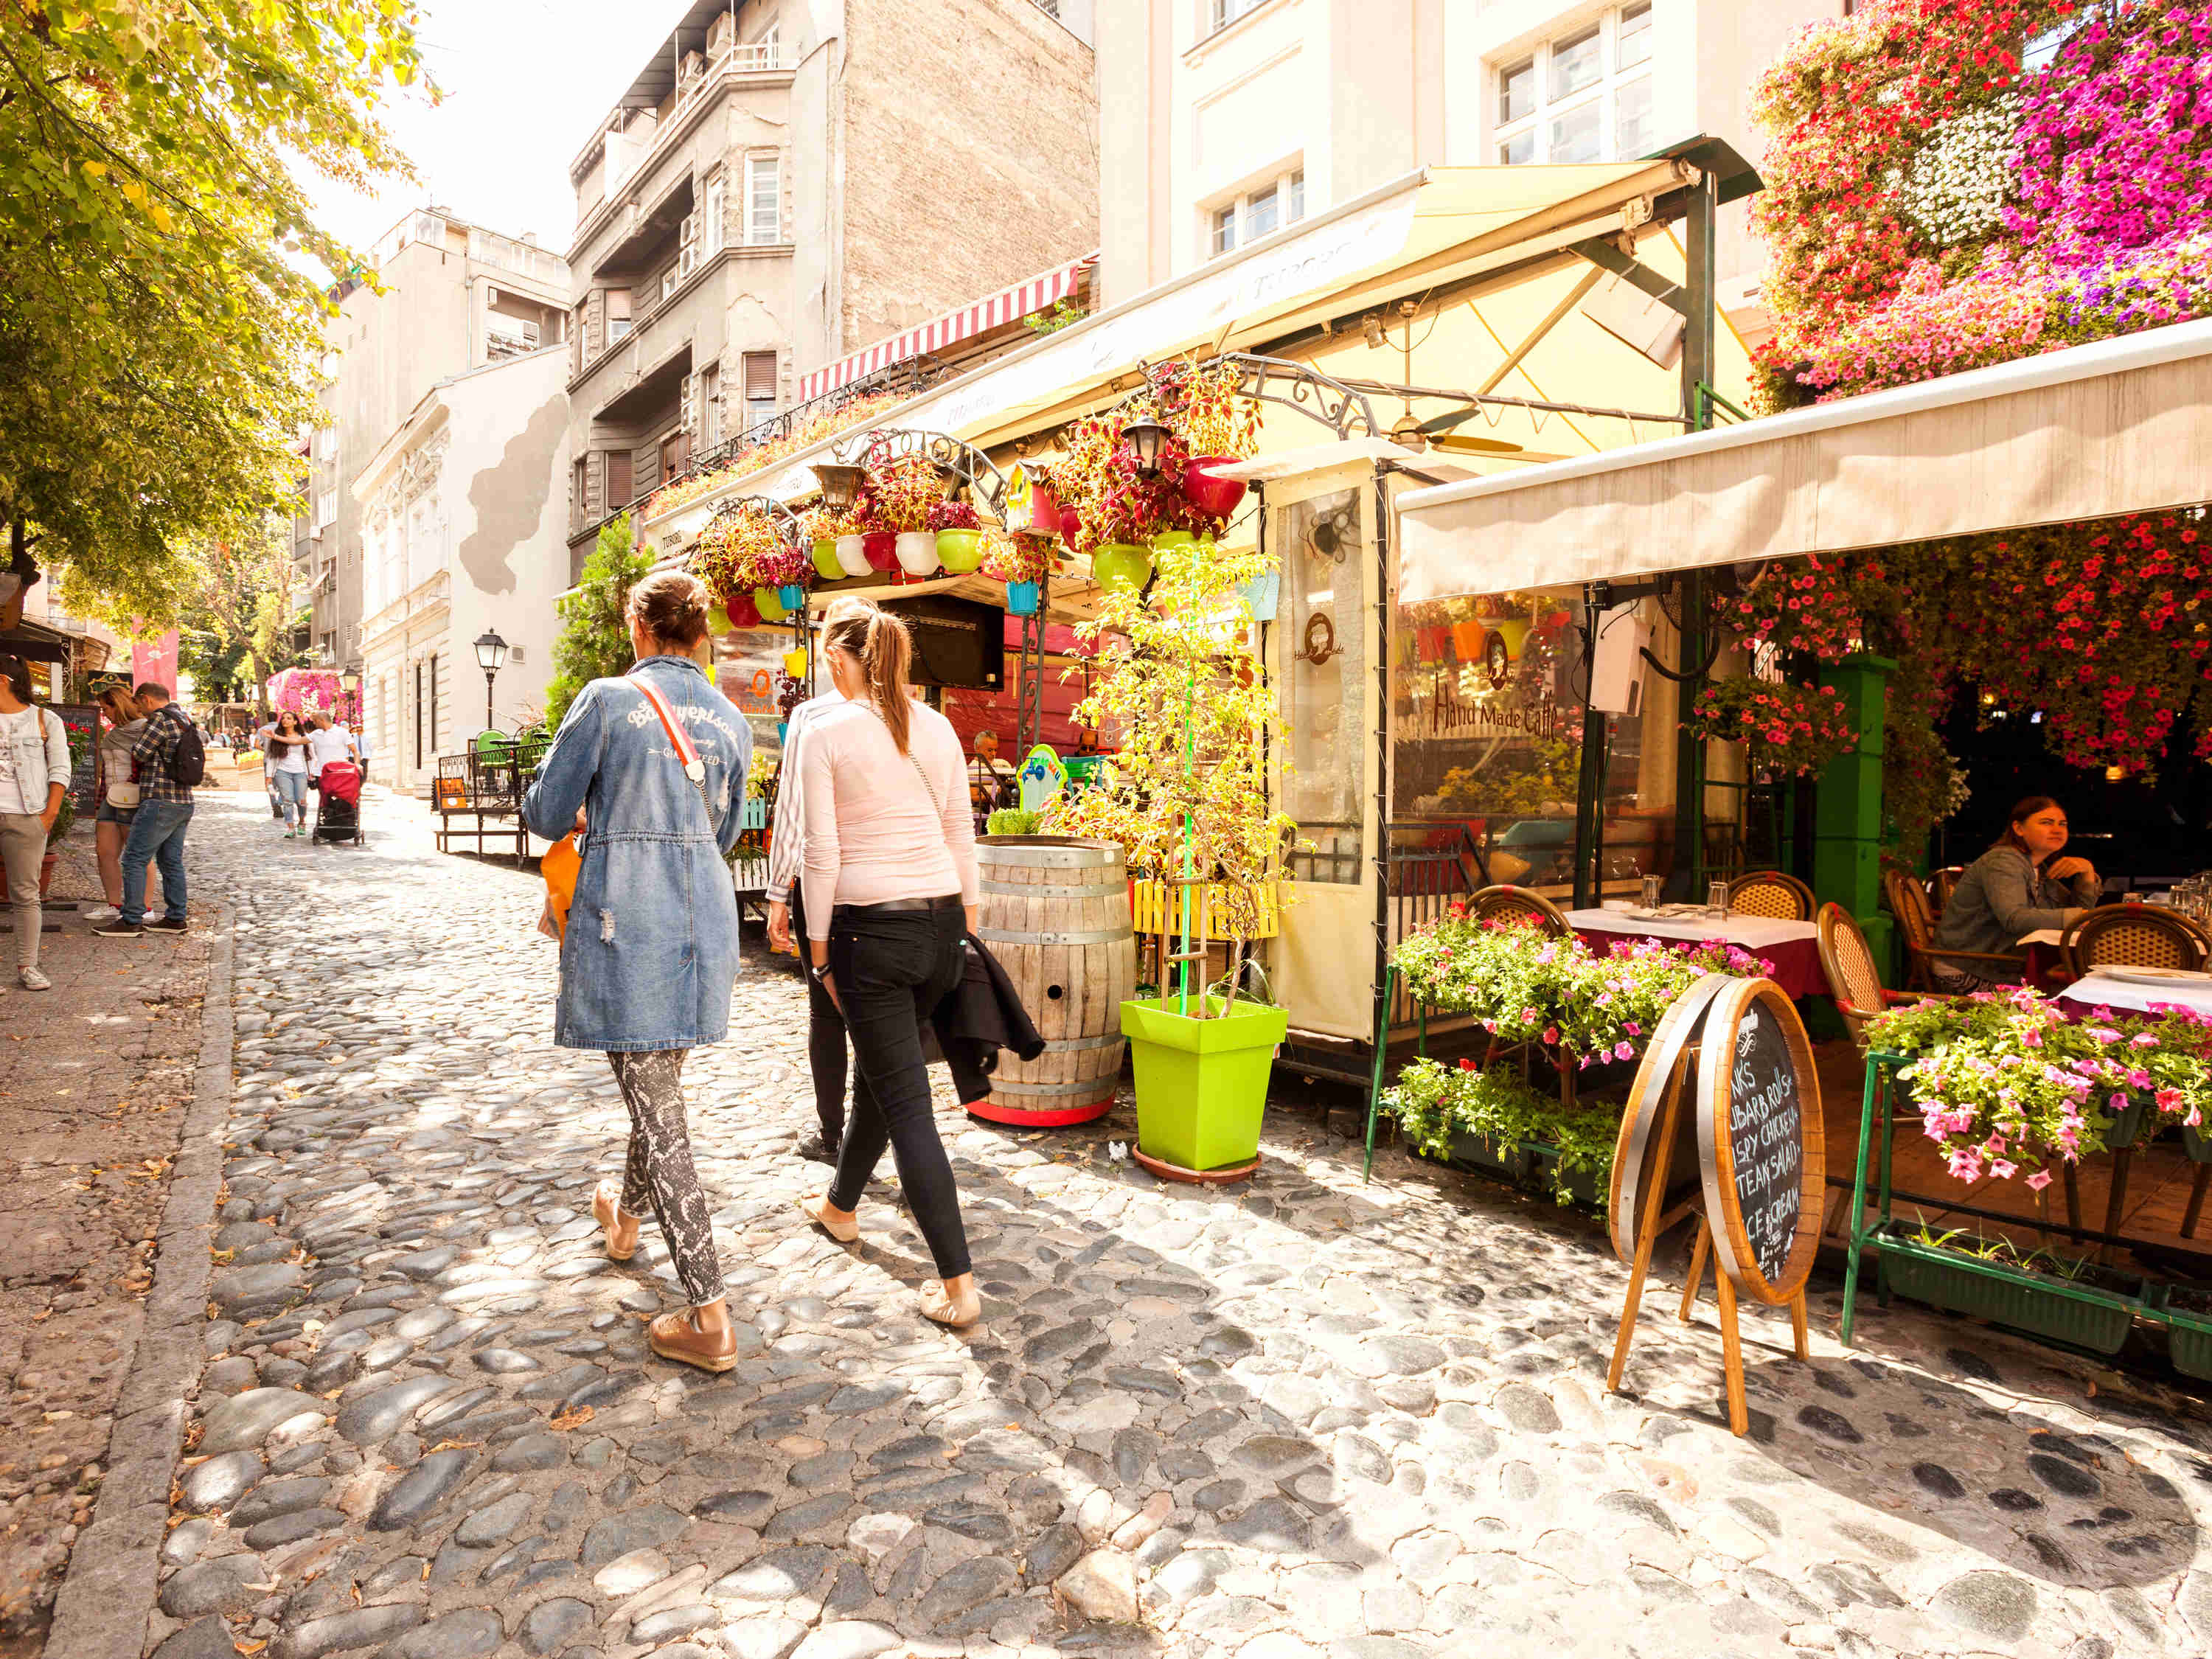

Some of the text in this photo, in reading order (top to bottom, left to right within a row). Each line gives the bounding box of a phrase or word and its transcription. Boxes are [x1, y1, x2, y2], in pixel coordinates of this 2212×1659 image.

[1433, 672, 1475, 733] Hand
[1480, 703, 1521, 728] Made
[1761, 1105, 1795, 1146] CHICKEN
[1742, 1186, 1800, 1241] CE CREAM
